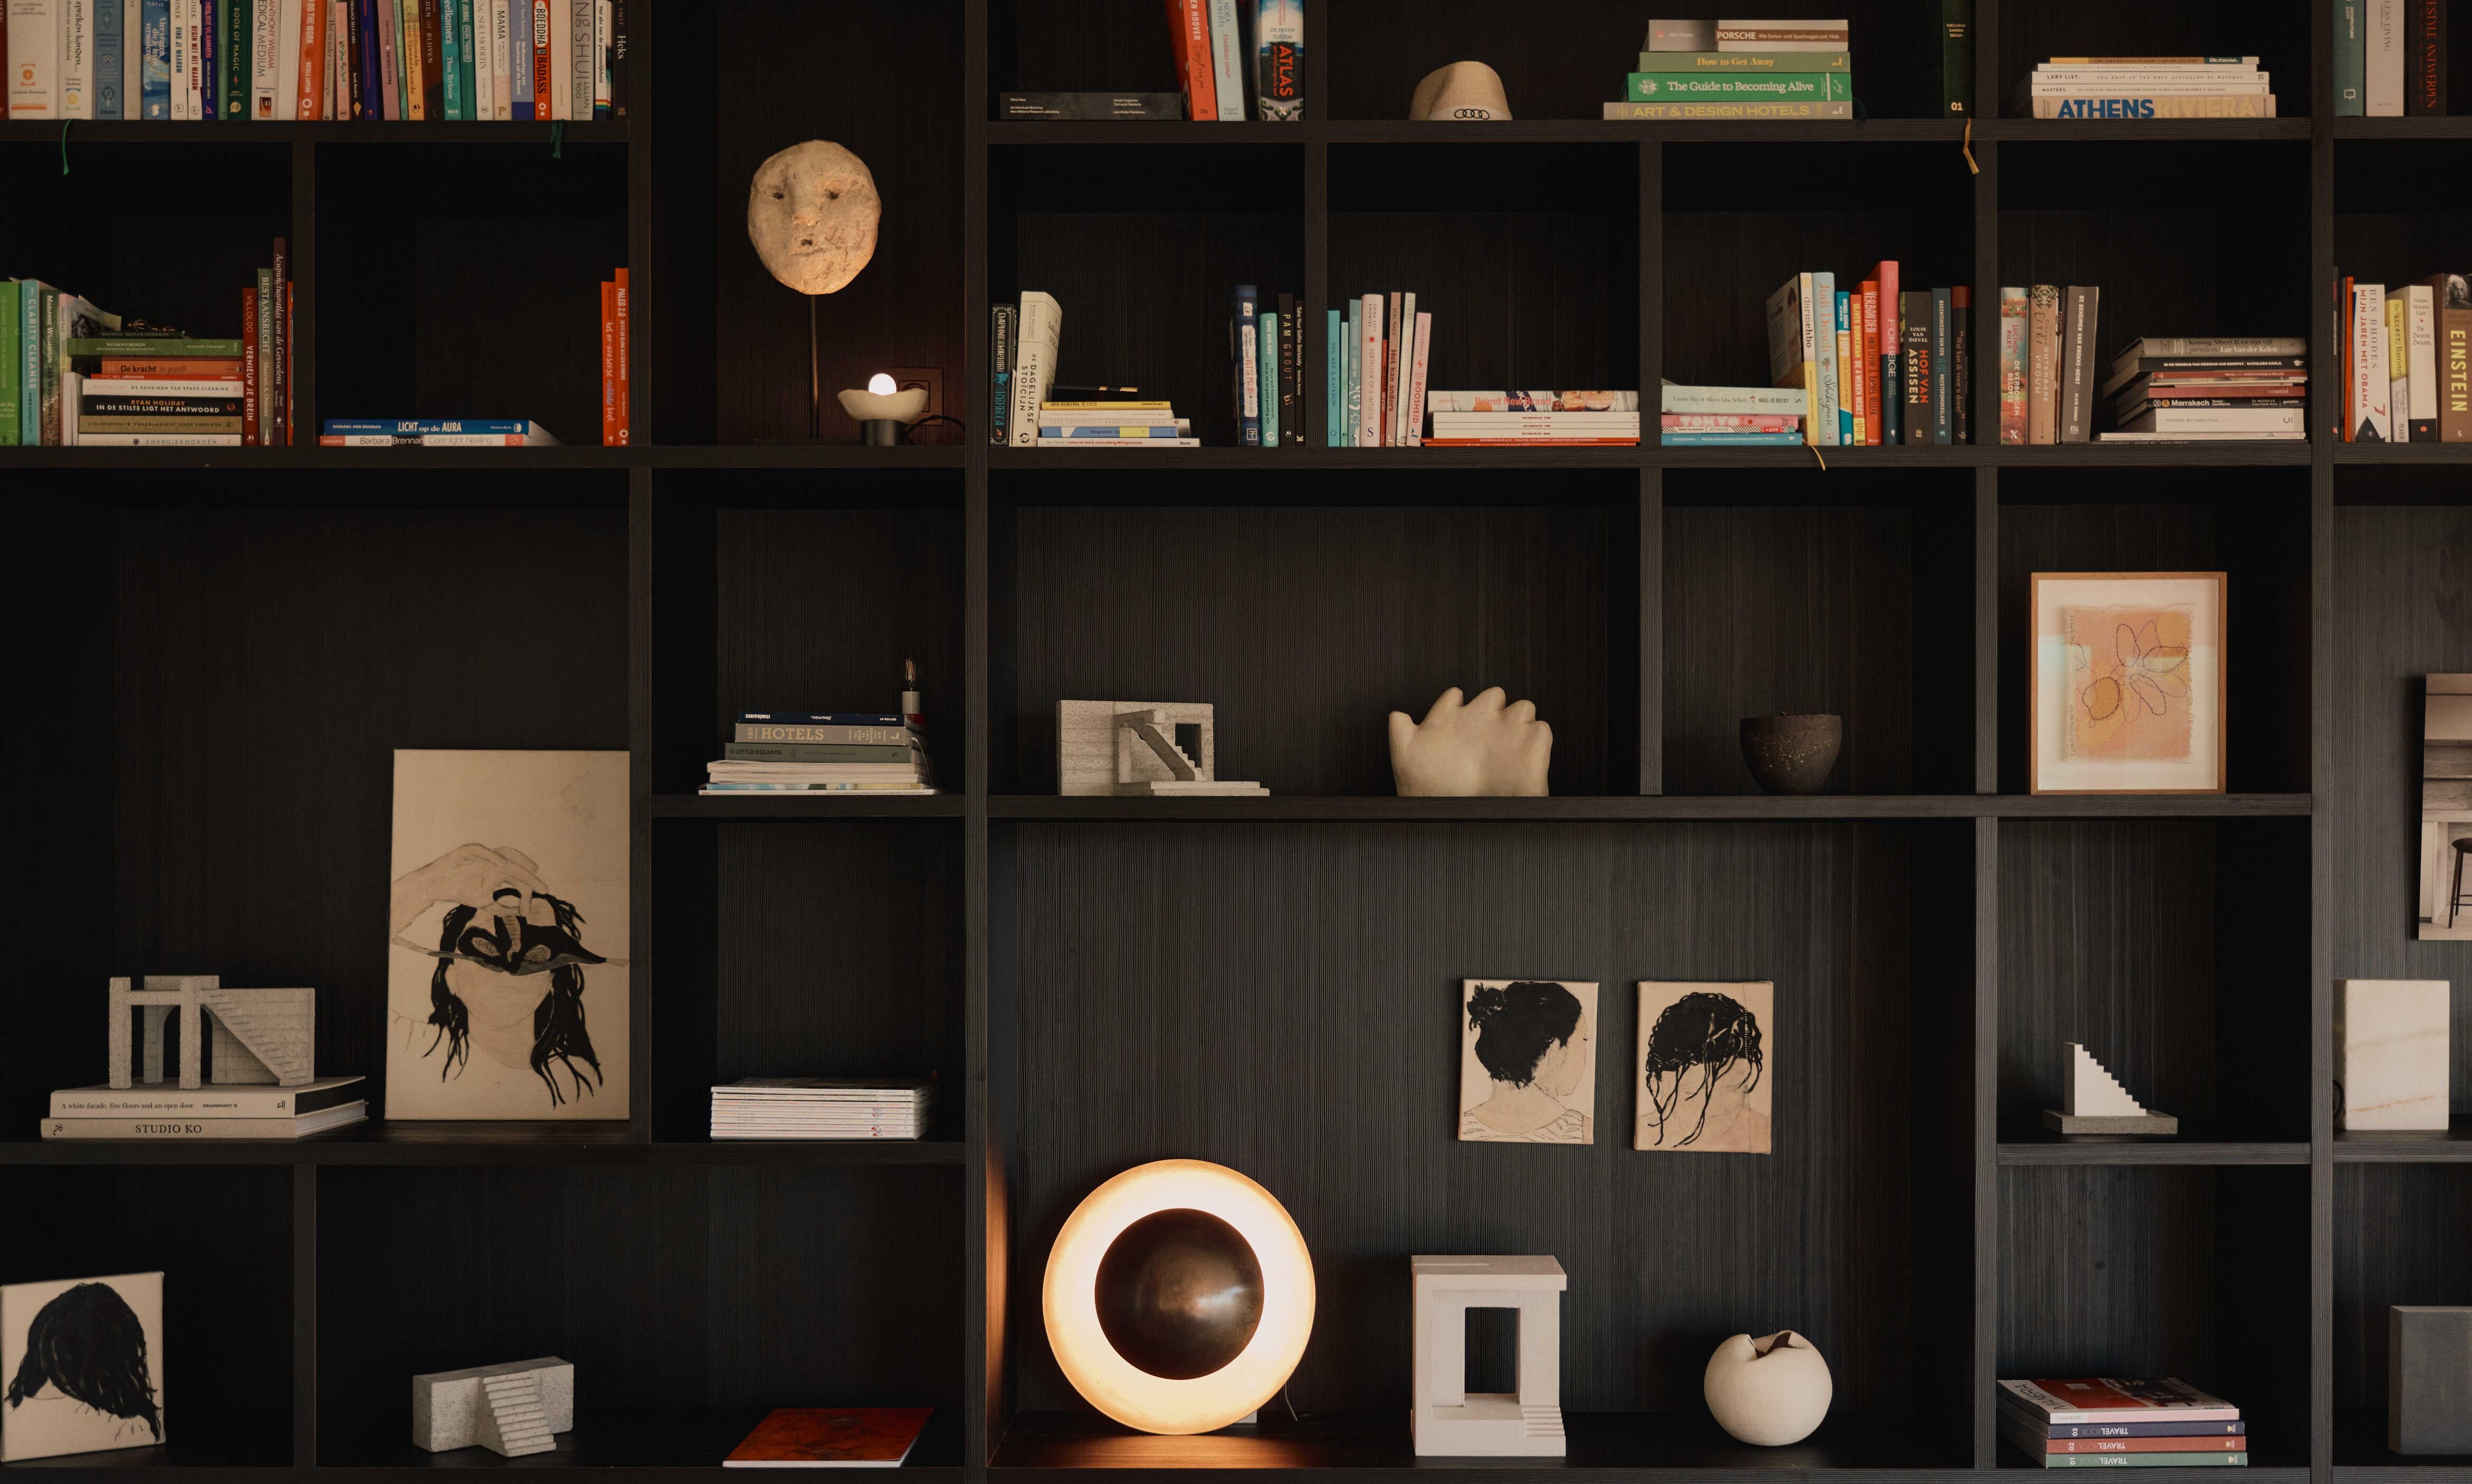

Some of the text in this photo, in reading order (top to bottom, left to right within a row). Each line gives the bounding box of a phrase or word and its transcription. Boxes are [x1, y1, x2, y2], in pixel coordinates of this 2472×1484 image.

[307, 3, 315, 12] DO
[537, 8, 546, 45] BOEDDHA
[75, 1, 85, 72] spreken konden...
[234, 32, 241, 41] OF
[617, 35, 626, 59] Heks
[1279, 45, 1293, 96] ATLAS
[1751, 58, 1775, 68] Away
[537, 57, 547, 94] BADASS
[1667, 81, 1686, 91] The
[1689, 81, 1720, 91] Guide
[1722, 82, 1732, 91] to
[1735, 81, 1786, 95] Becoming
[1788, 82, 1814, 91] Alive
[1634, 106, 1809, 116] ART & DESIGN HOTELS
[1951, 102, 1963, 110] 01
[2058, 99, 2155, 119] ATHENS
[2156, 97, 2258, 119] RIVIERA
[262, 277, 271, 354] BESTAANSRECHT
[1819, 284, 1833, 354] Judi Dench
[1865, 291, 1877, 332] VERBONDEN
[1804, 297, 1813, 348] darmehbo
[274, 347, 284, 385] Gevoelens
[1283, 345, 1292, 379] GROUT
[1855, 360, 1861, 369] DE
[2014, 361, 2020, 370] DE
[2450, 330, 2467, 411] EINSTEIN
[1908, 349, 1918, 404] ASSISEN
[1919, 350, 1929, 404] HOF VAN
[246, 388, 254, 397] JE
[1020, 366, 1028, 411] STOÏCIJN
[1027, 365, 1036, 423] DAGELIJKSE
[1412, 382, 1422, 423] BOOSHEID
[1475, 397, 1551, 405] Brand New Brand
[398, 422, 418, 432] LICHT
[441, 422, 462, 432] AURA
[359, 436, 390, 444] Barbara
[448, 437, 464, 446] light
[466, 437, 492, 446] healing
[761, 728, 824, 740] HOTELS
[135, 1124, 202, 1134] STUDIO KO
[2072, 1427, 2078, 1436] 03
[2069, 1442, 2074, 1451] 02
[2070, 1457, 2076, 1466] 01
